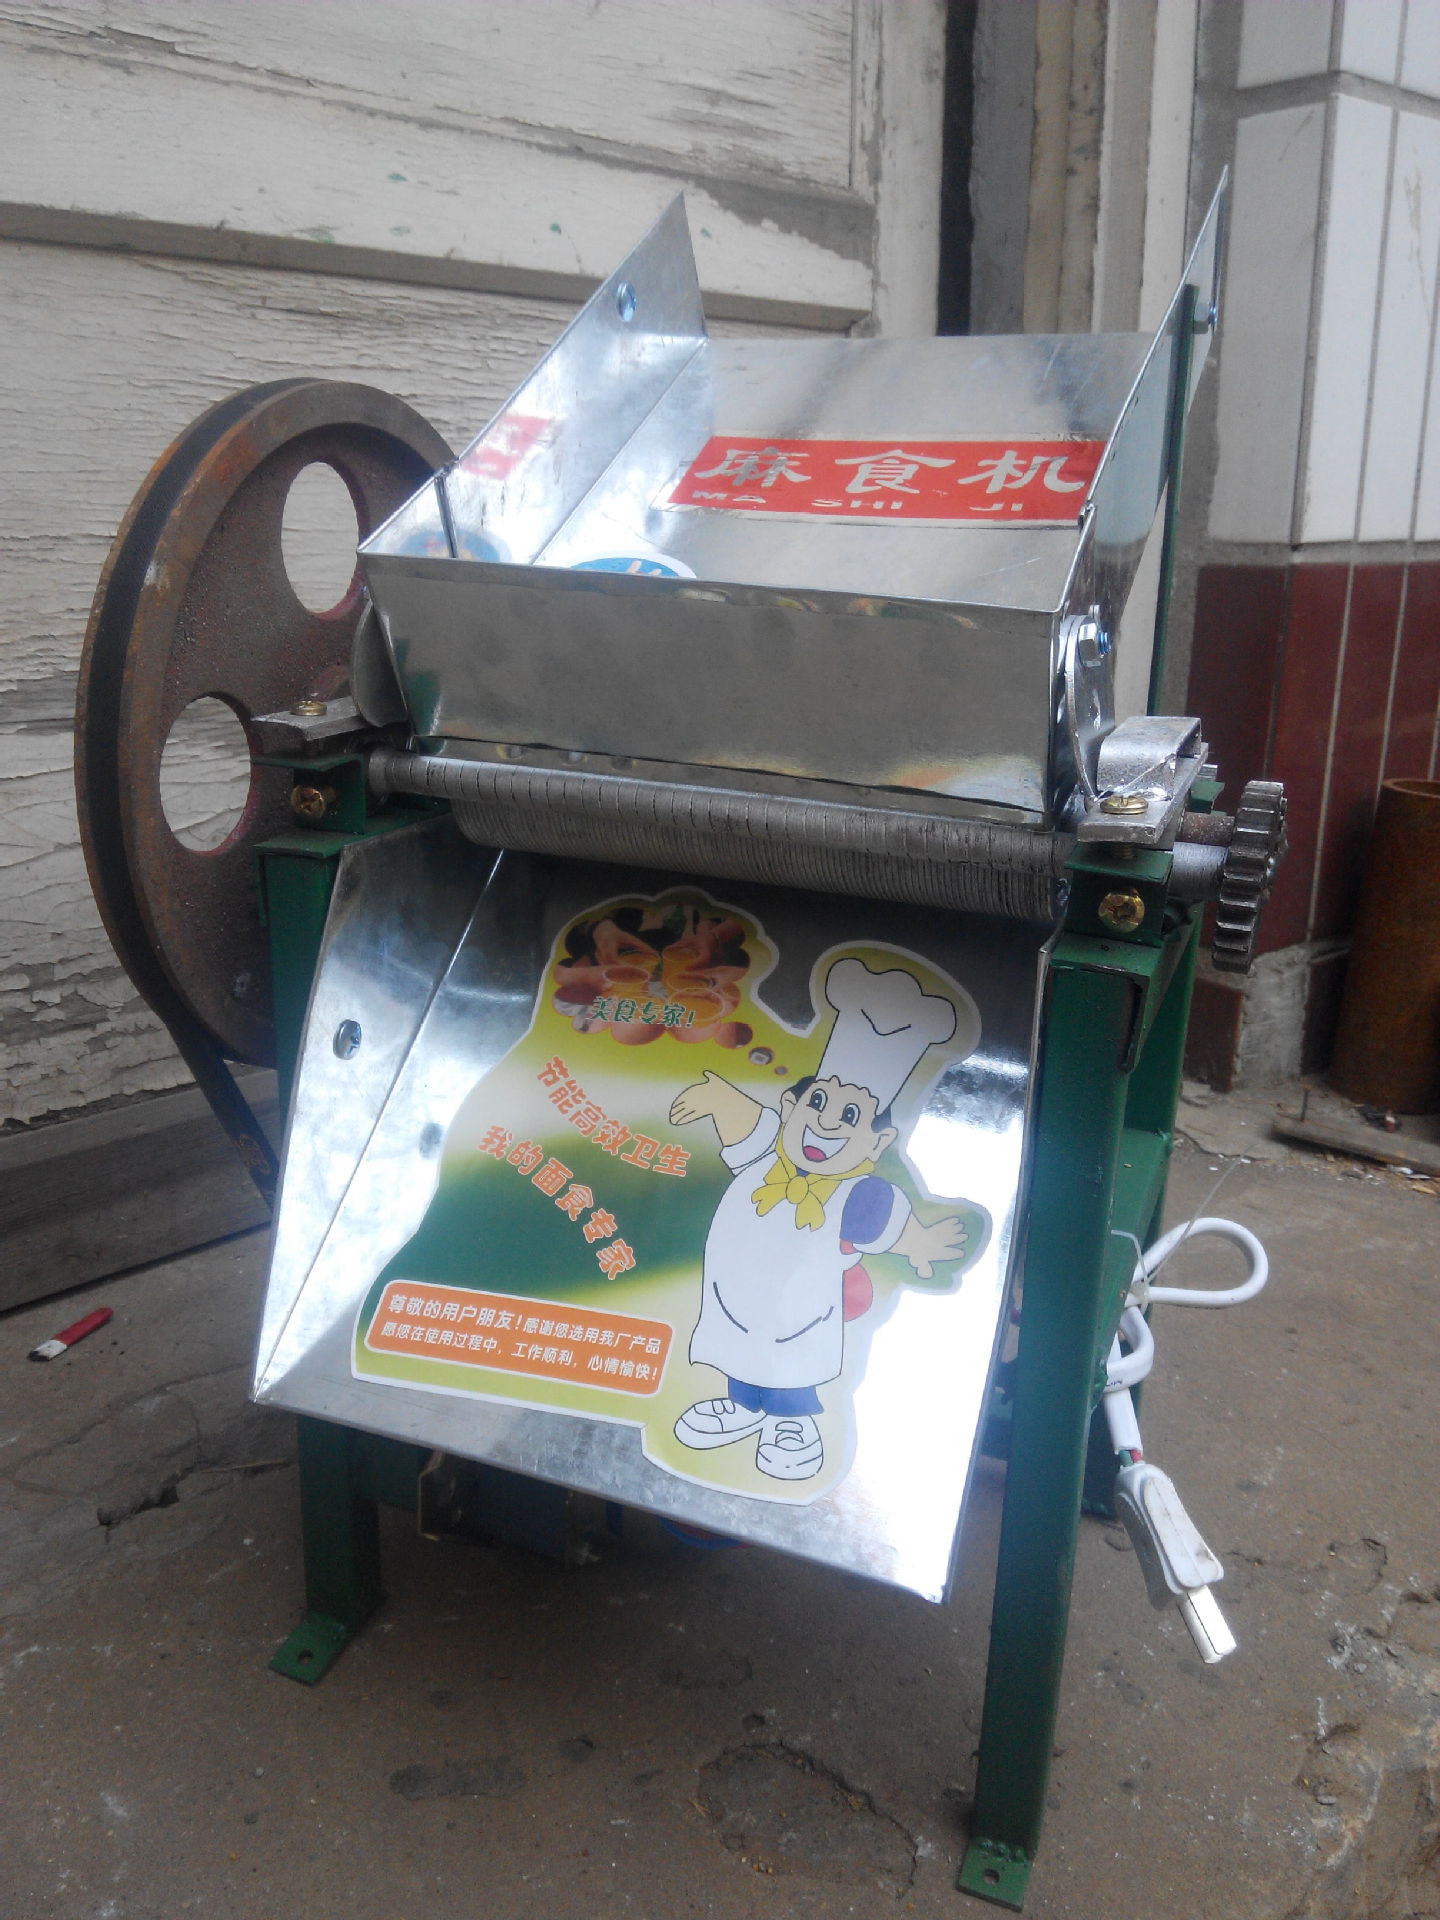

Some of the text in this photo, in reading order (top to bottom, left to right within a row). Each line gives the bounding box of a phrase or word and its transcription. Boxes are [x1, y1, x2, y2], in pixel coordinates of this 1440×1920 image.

[692, 490, 1023, 512] MA SHI JI
[693, 447, 1085, 494] 麻食机
[536, 1055, 692, 1177] 节能高效卫生
[477, 1124, 637, 1281] 我的面食专家
